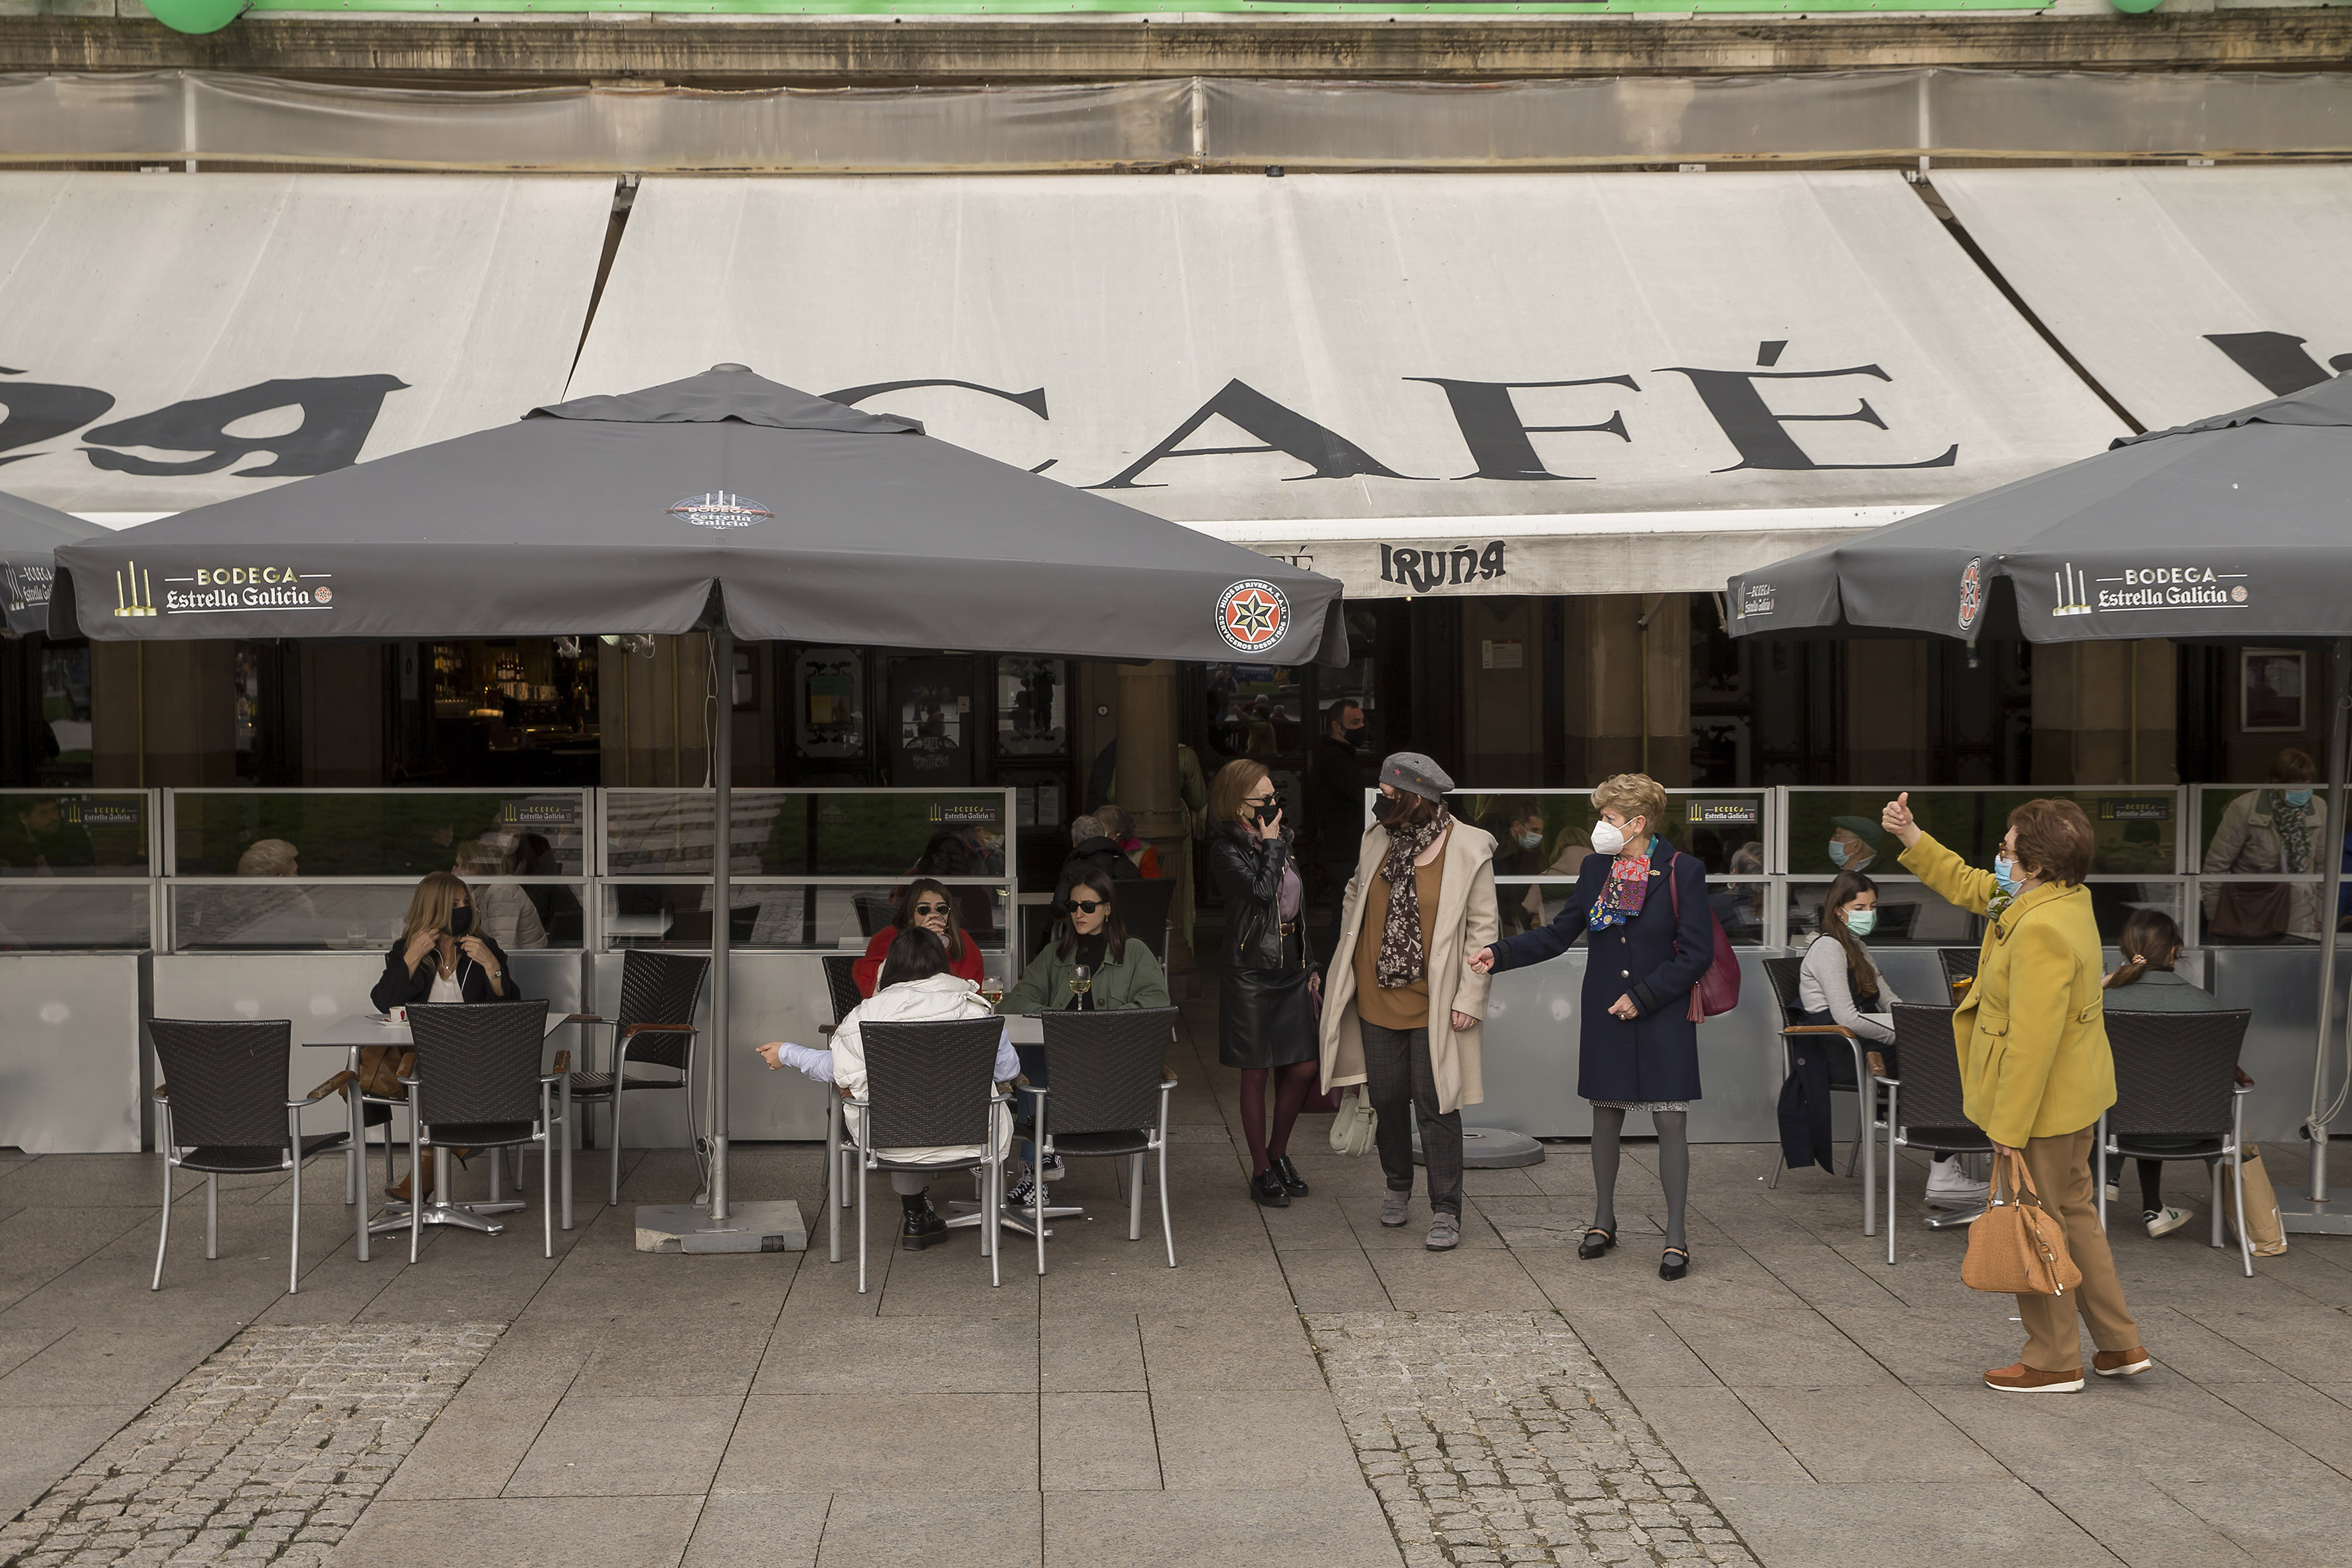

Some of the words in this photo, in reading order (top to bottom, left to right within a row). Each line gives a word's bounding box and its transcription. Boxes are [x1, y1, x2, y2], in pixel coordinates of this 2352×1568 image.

[688, 513, 751, 522] Estrella
[197, 566, 298, 586] BODEGA
[2125, 567, 2217, 585] BODEGA
[166, 589, 240, 609] Estrella
[242, 586, 310, 607] Galicia
[1219, 588, 1235, 609] HIJOS
[1233, 584, 1245, 592] DE
[2098, 588, 2163, 607] Estrella
[2165, 586, 2228, 605] Galicia
[1218, 615, 1252, 651] CERVECEROS
[1253, 637, 1275, 651] DESDE
[1274, 621, 1287, 639] 1906
